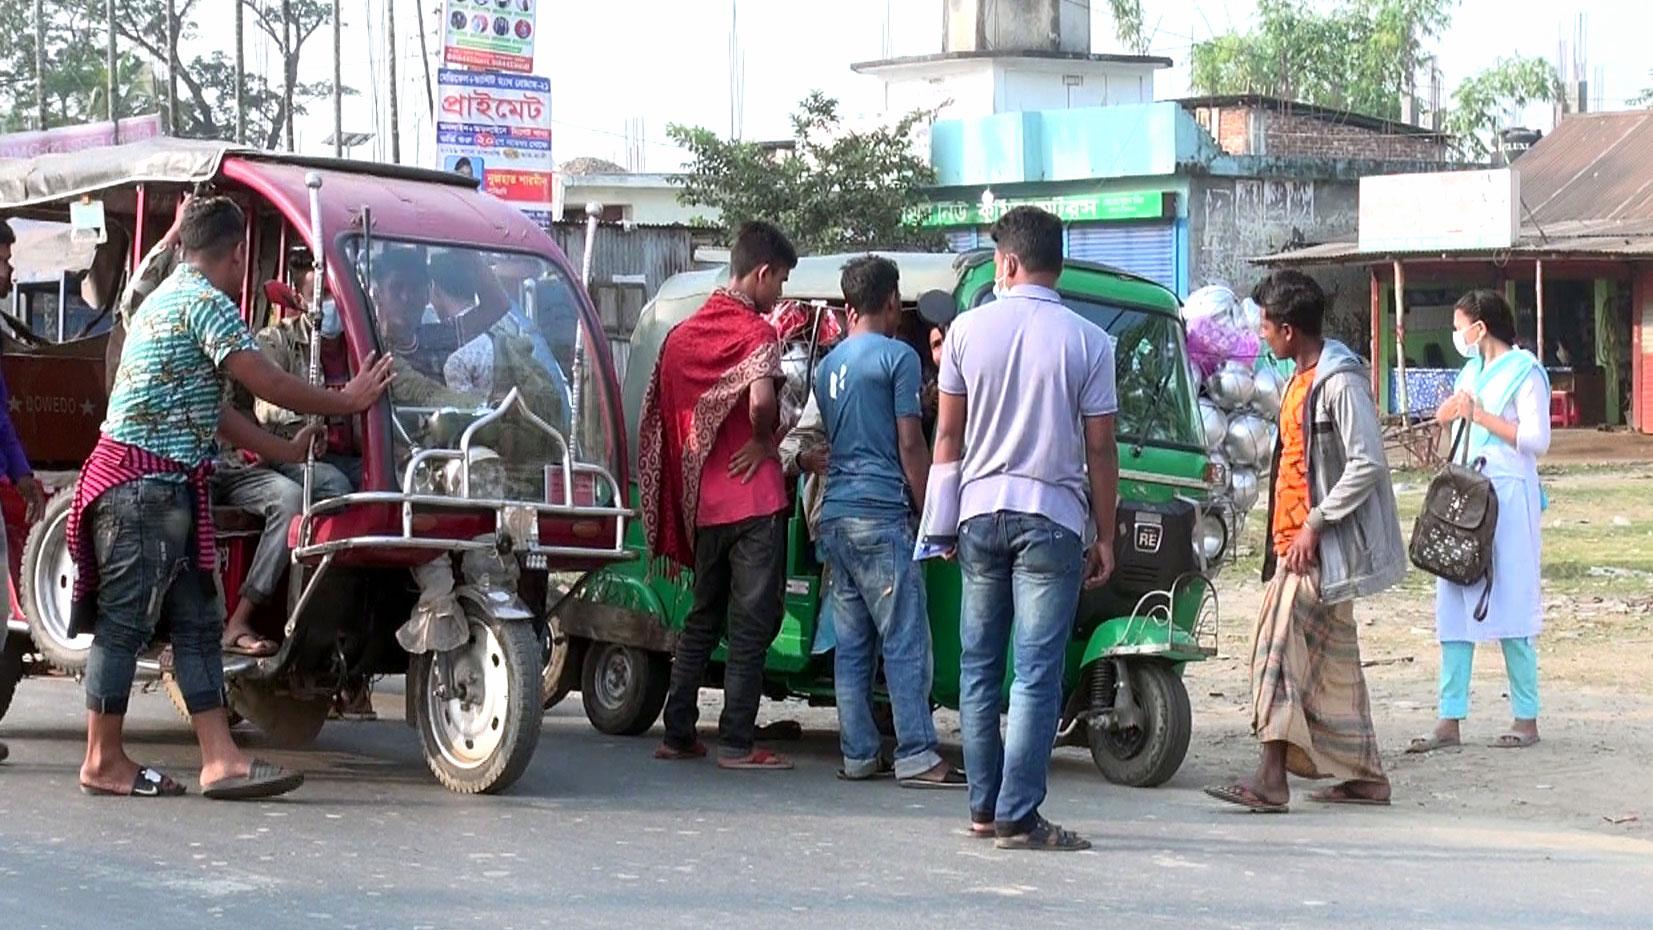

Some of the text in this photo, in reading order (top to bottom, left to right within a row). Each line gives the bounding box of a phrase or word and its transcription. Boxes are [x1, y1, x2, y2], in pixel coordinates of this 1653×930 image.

[442, 90, 545, 121] প্রাইমেট
[475, 134, 494, 147] ২০
[938, 201, 969, 223] নিউ
[1139, 532, 1157, 546] RE
